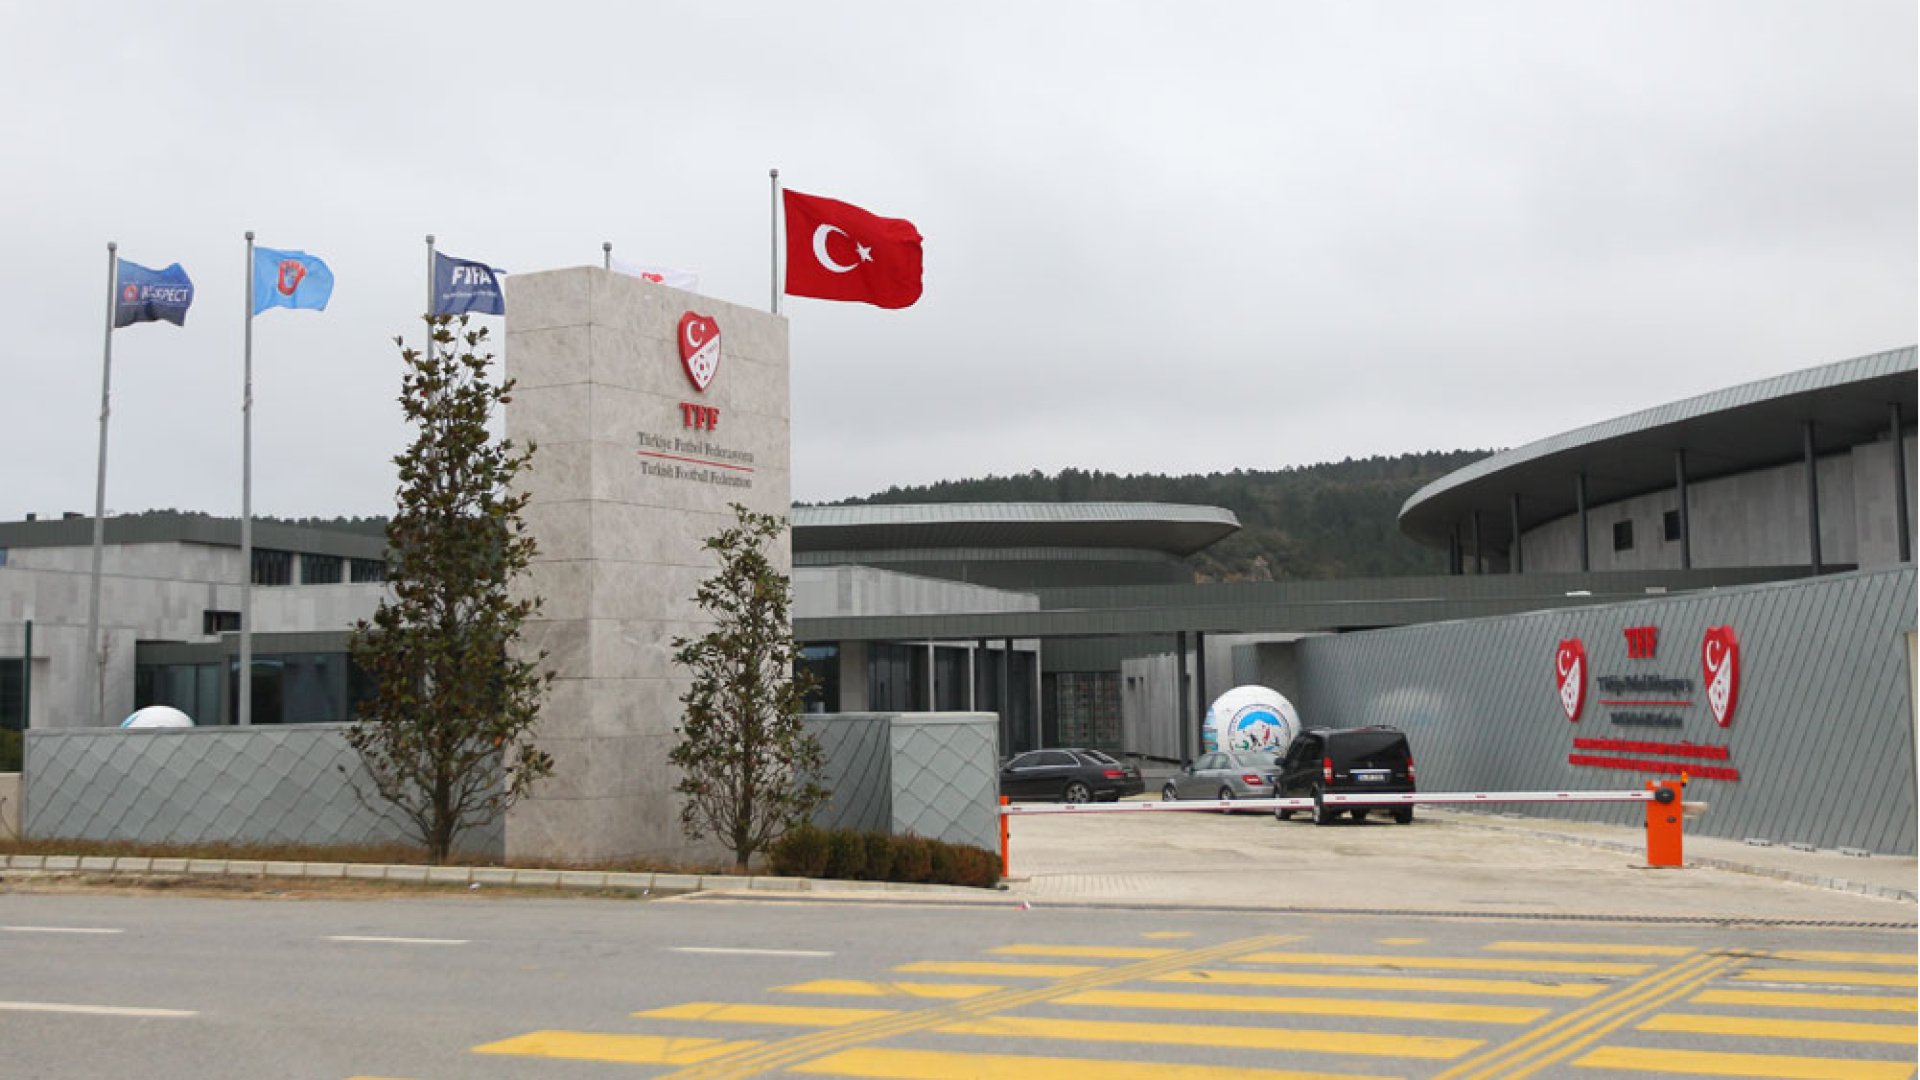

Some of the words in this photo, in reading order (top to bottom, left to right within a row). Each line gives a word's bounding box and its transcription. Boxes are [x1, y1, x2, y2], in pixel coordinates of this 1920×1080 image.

[452, 265, 492, 285] FIFA
[679, 402, 720, 431] TFF
[674, 437, 703, 454] Futbol
[640, 461, 674, 478] Turkish
[674, 465, 709, 482] Football
[711, 471, 753, 488] Federation
